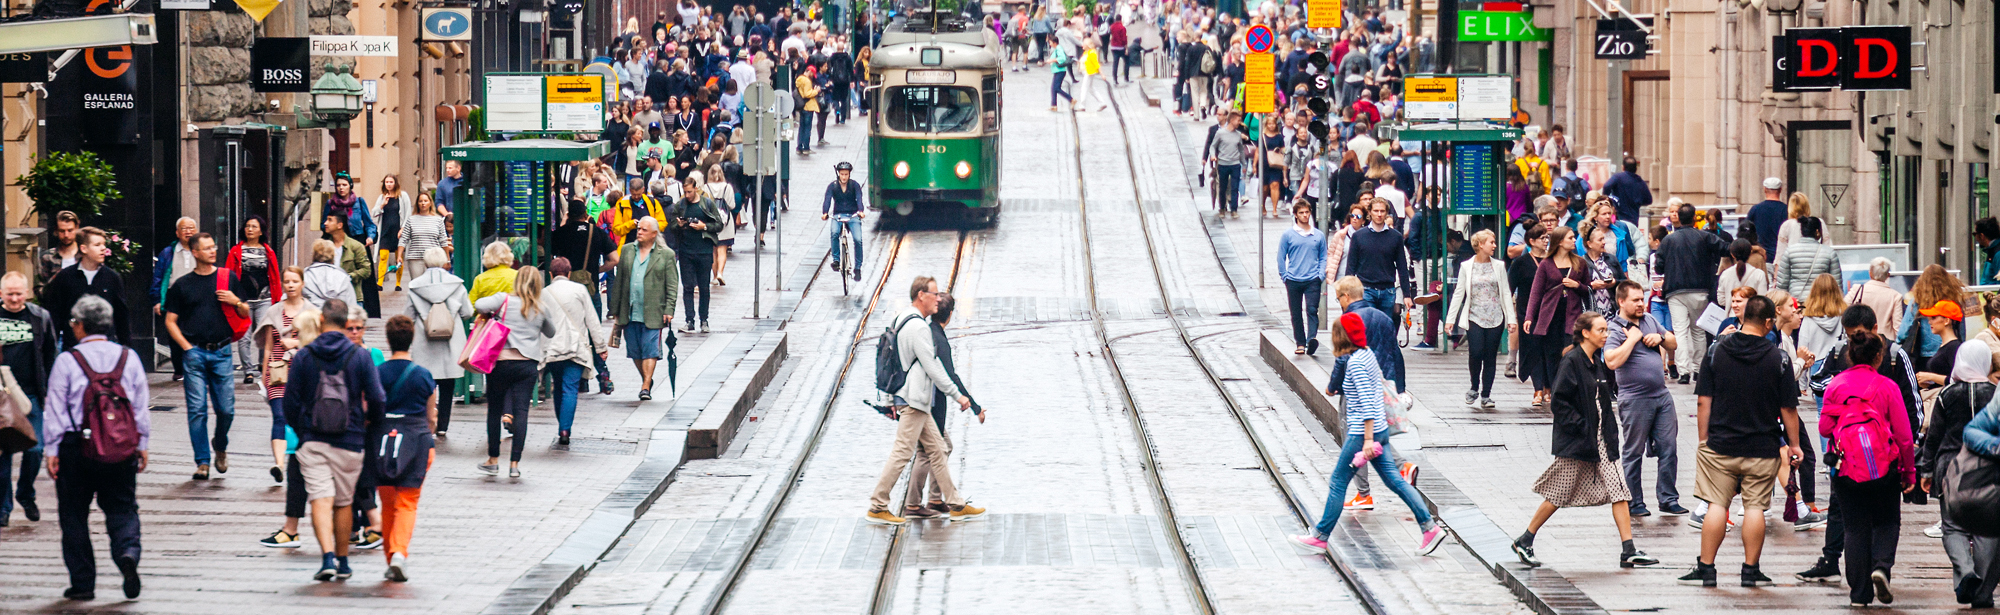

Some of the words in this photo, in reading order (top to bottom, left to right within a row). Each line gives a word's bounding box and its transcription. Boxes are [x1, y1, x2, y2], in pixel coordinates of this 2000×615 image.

[312, 40, 348, 54] Filippa
[350, 40, 359, 52] K
[383, 41, 391, 52] K
[1597, 34, 1635, 55] Zio
[262, 68, 303, 81] BOSS
[487, 77, 492, 85] 5
[1315, 75, 1327, 90] S
[487, 86, 492, 94] 7
[1460, 86, 1465, 94] 5
[84, 93, 134, 101] GALLERIA
[84, 101, 134, 109] ESPLANAD
[548, 113, 553, 121] 2
[921, 145, 946, 154] 150
